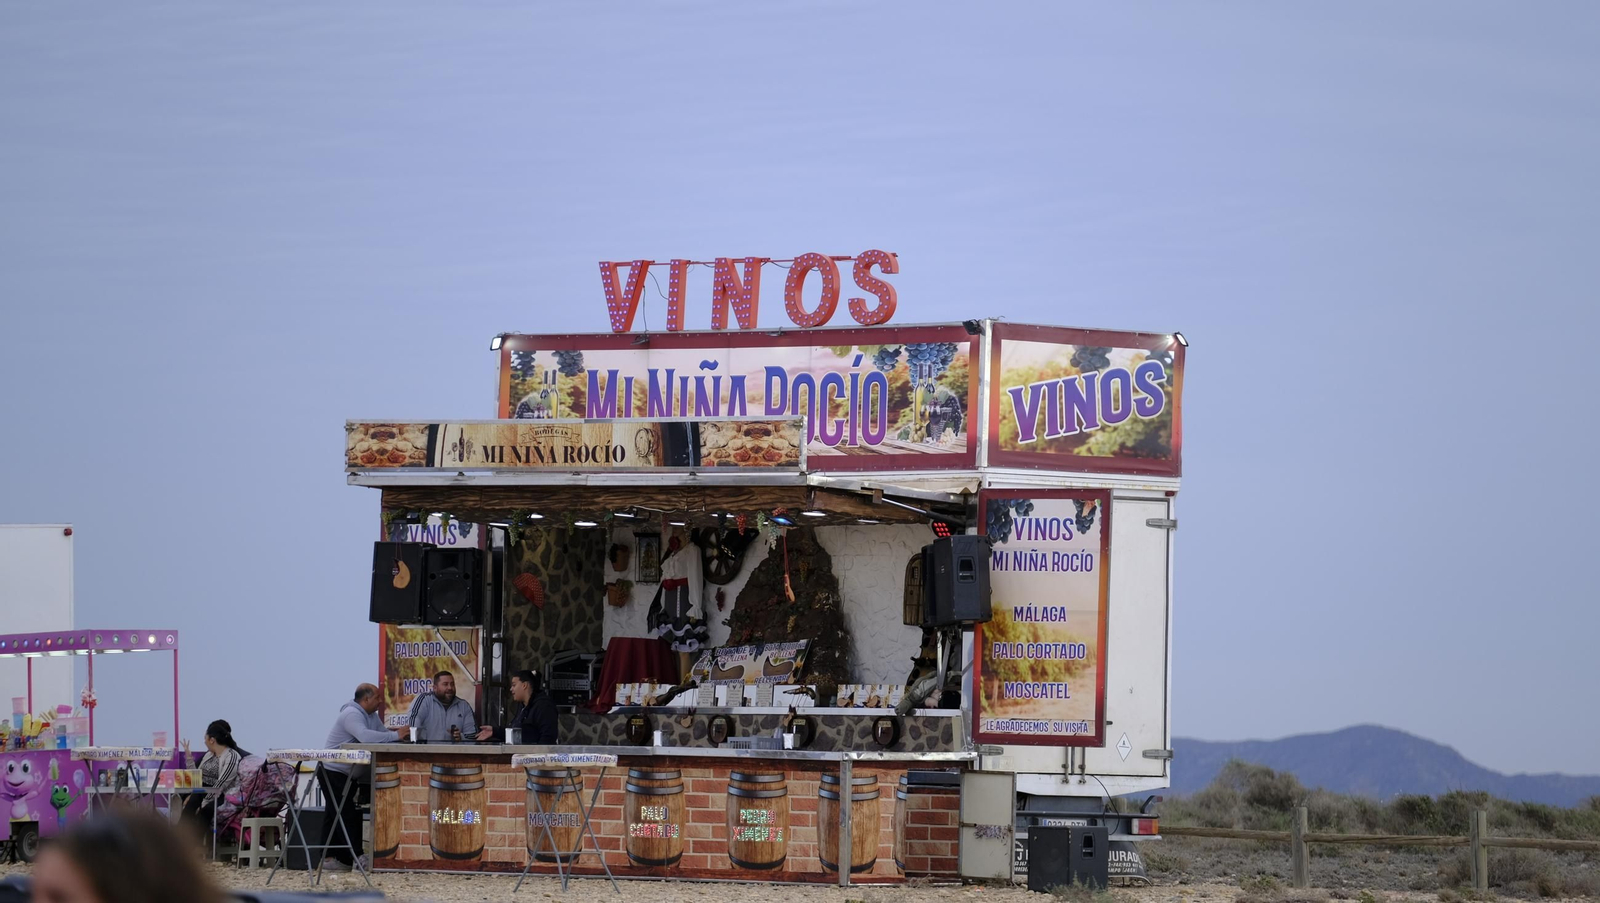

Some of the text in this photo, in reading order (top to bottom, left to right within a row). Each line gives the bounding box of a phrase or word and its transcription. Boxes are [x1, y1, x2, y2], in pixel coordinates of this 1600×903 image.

[599, 249, 899, 333] VINOS
[587, 368, 635, 419] MI
[647, 359, 748, 419] NIÑA
[1007, 359, 1167, 444] VINOS
[534, 427, 569, 437] BODEGAS
[482, 439, 626, 464] MI NIÑA ROCÍO
[1013, 517, 1074, 541] VINOS
[992, 549, 1094, 572] MI NIÑA ROCÍO
[1013, 603, 1067, 622] MÁLAGA
[394, 641, 420, 658] PALO
[993, 643, 1086, 660] PALO CORTADO
[404, 678, 433, 696] MOSC
[1004, 682, 1070, 699] MOSCATEL
[986, 720, 1089, 733] LE AGRADECEMOS SU VISITA
[431, 807, 481, 825] MÁLAGA
[641, 805, 668, 821] PALO
[739, 808, 777, 824] PEDRO
[629, 823, 680, 838] CORTADO
